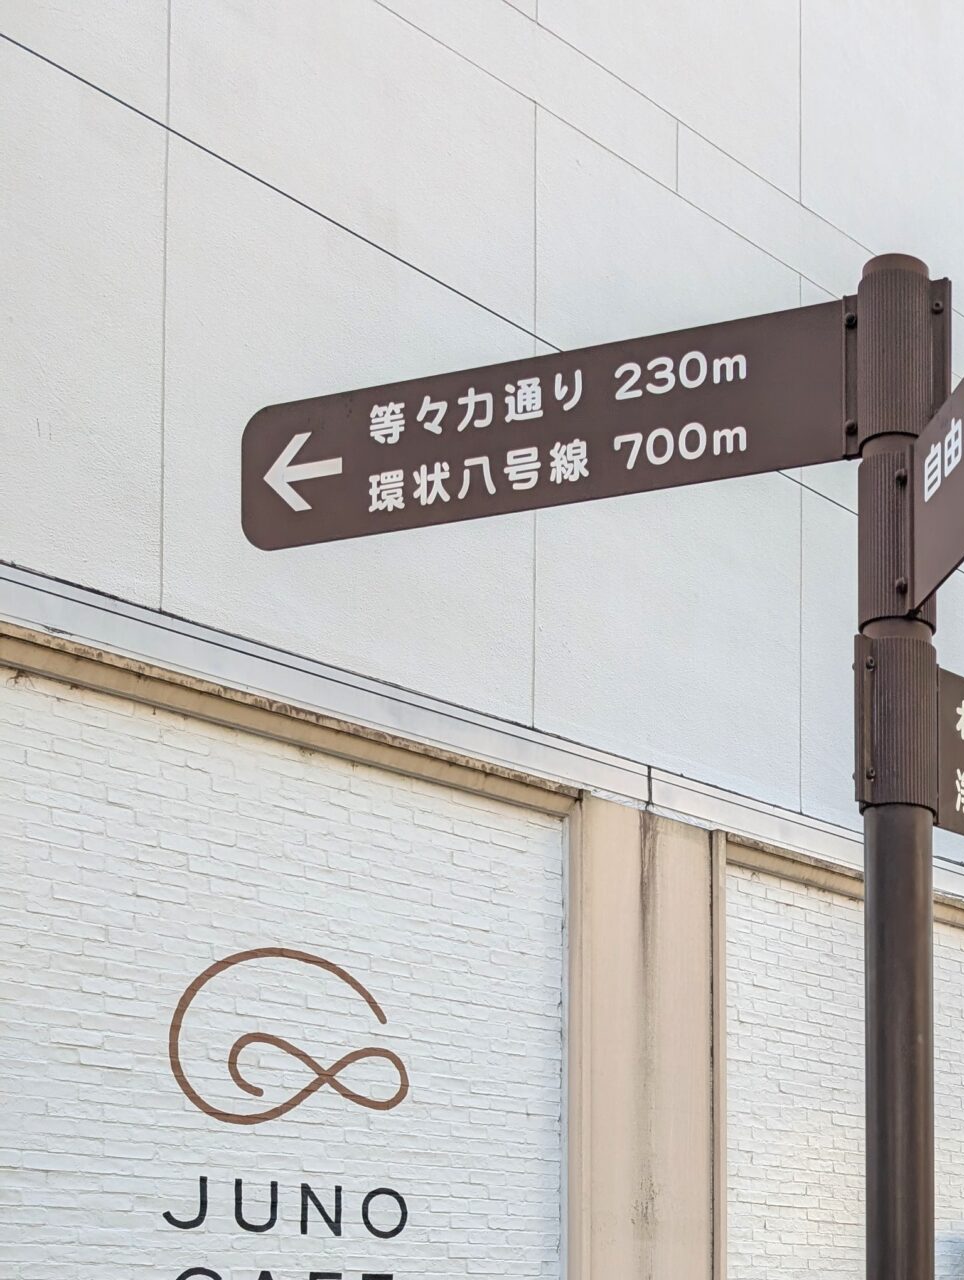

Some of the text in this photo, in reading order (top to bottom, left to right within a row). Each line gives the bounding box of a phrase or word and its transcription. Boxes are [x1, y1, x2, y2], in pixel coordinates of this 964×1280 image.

[369, 350, 747, 445] 等々力通り 230m
[368, 422, 747, 514] 環状八号線 700m
[162, 1175, 408, 1239] JUNO
